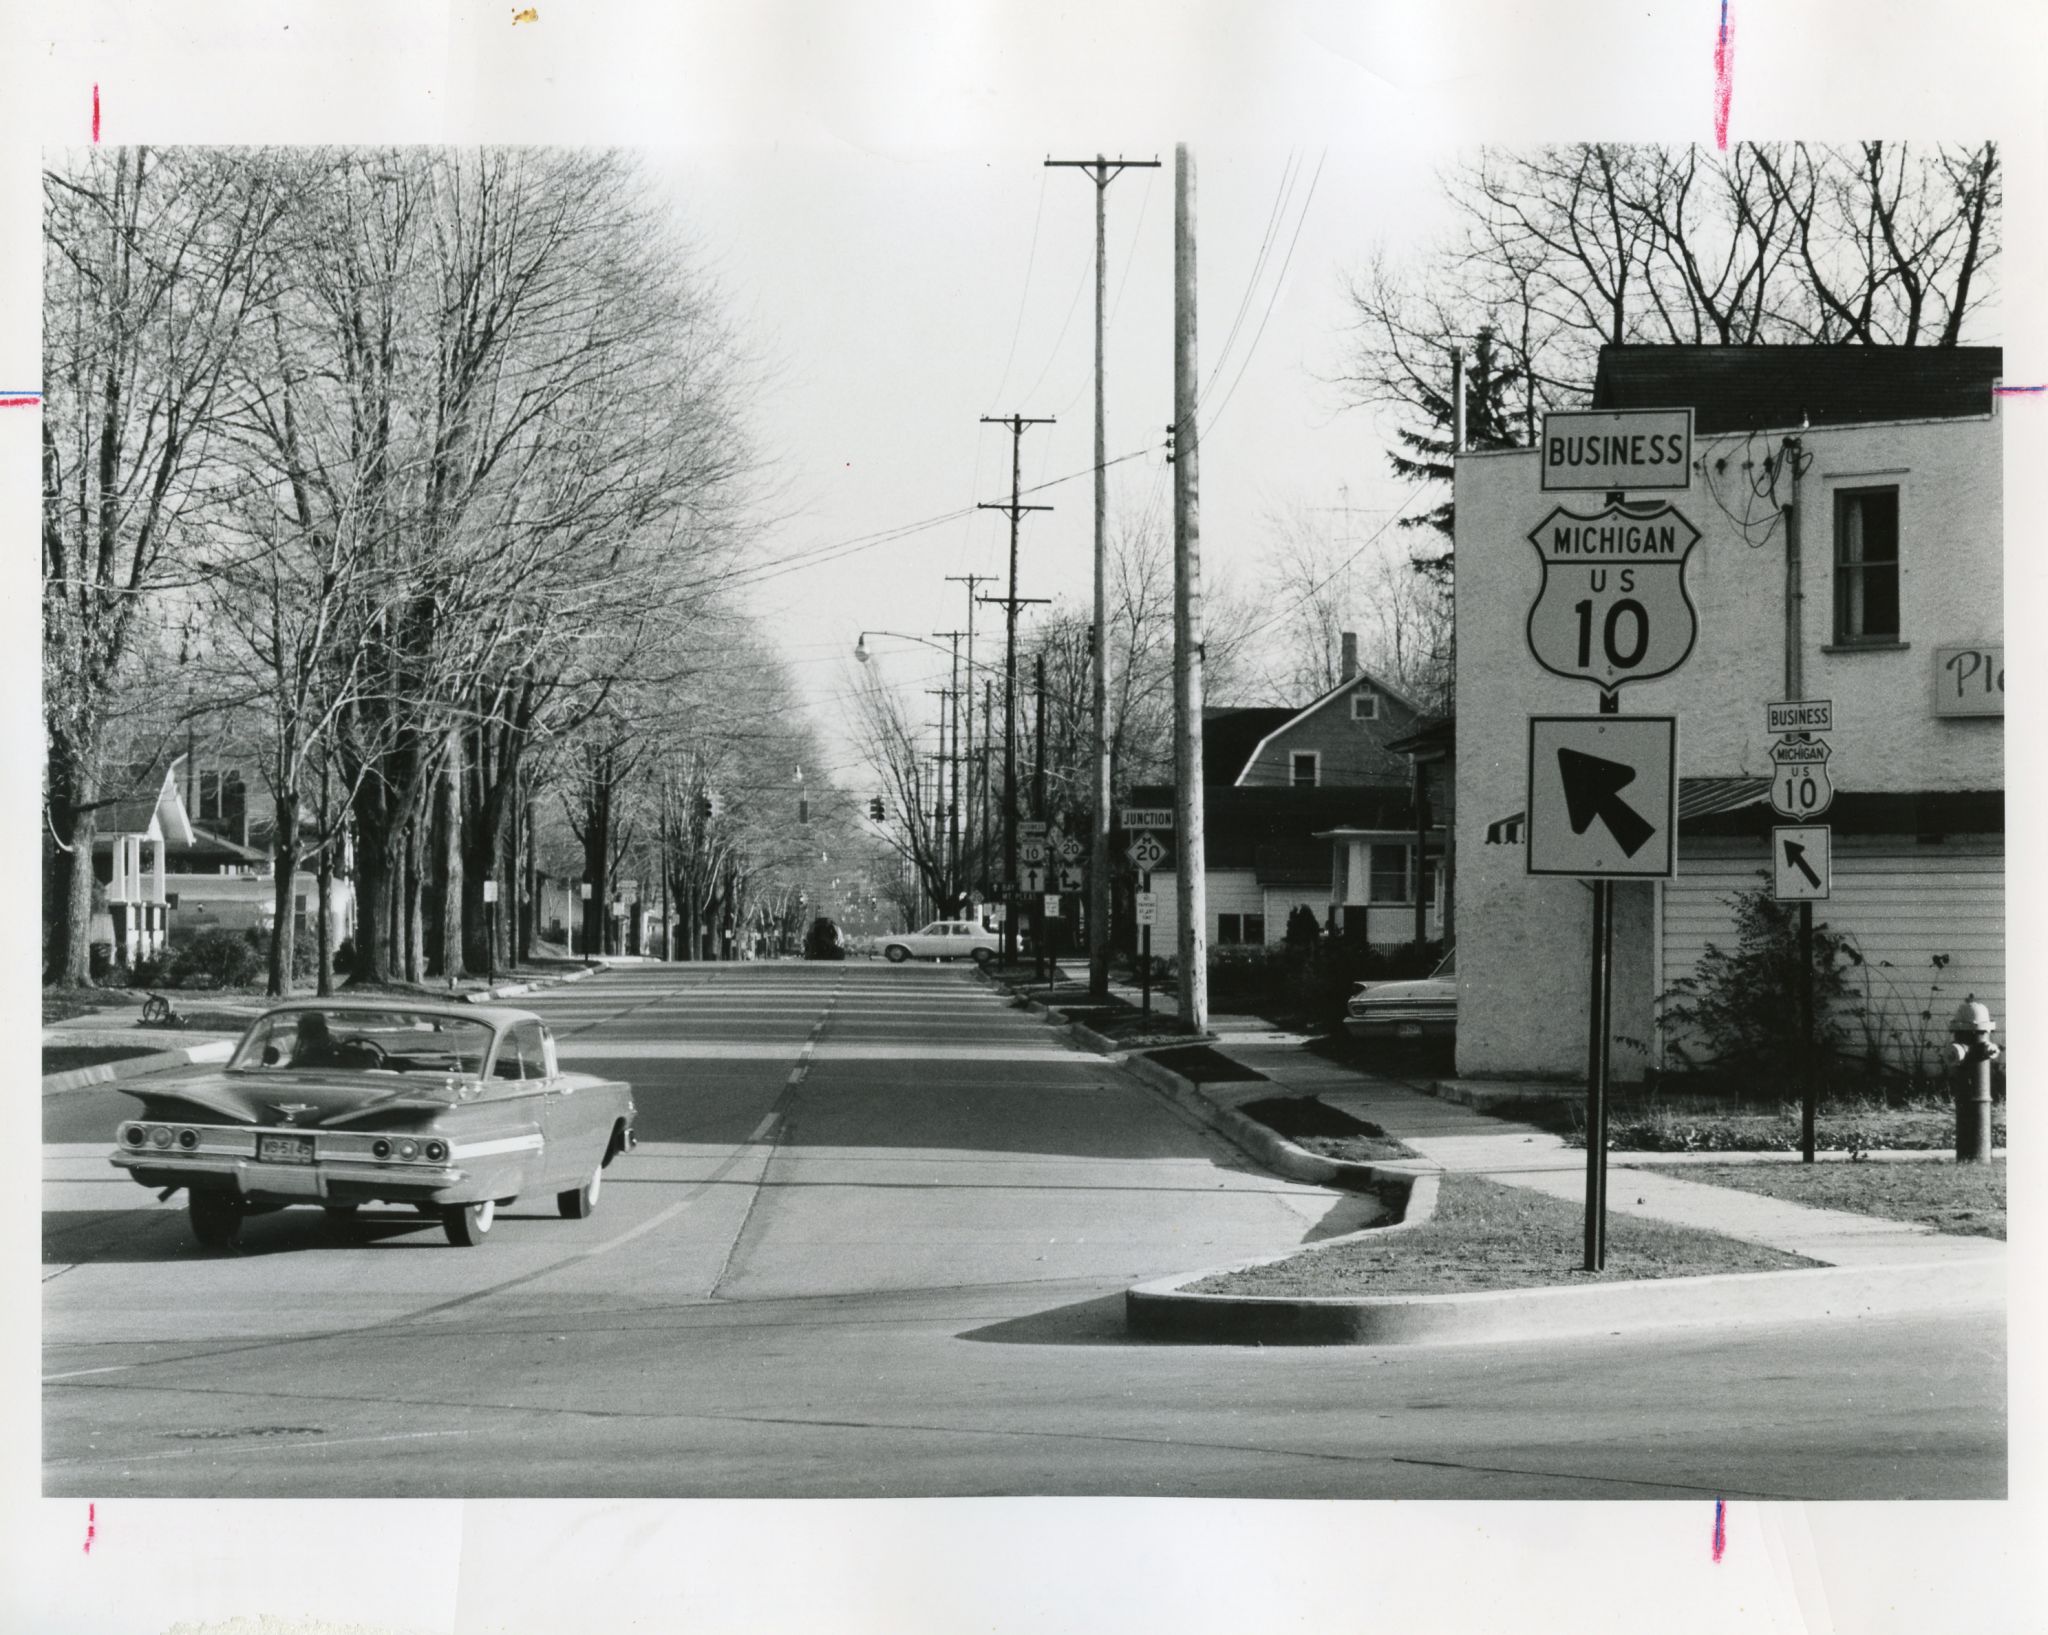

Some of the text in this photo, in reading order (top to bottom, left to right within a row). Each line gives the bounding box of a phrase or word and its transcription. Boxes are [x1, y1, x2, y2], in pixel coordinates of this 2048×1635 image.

[1549, 434, 1682, 466] BUSINESS
[1554, 526, 1675, 554] MICHIGAN
[1575, 598, 1649, 669] 10
[1771, 708, 1828, 726] BUSINESS
[1777, 748, 1824, 760] MICHIGAN
[1786, 778, 1816, 809] 10
[1124, 812, 1172, 825] JUNCTION
[1063, 843, 1080, 855] 20
[1142, 837, 1152, 845] M
[1025, 848, 1039, 860] 10
[1136, 845, 1160, 861] 20
